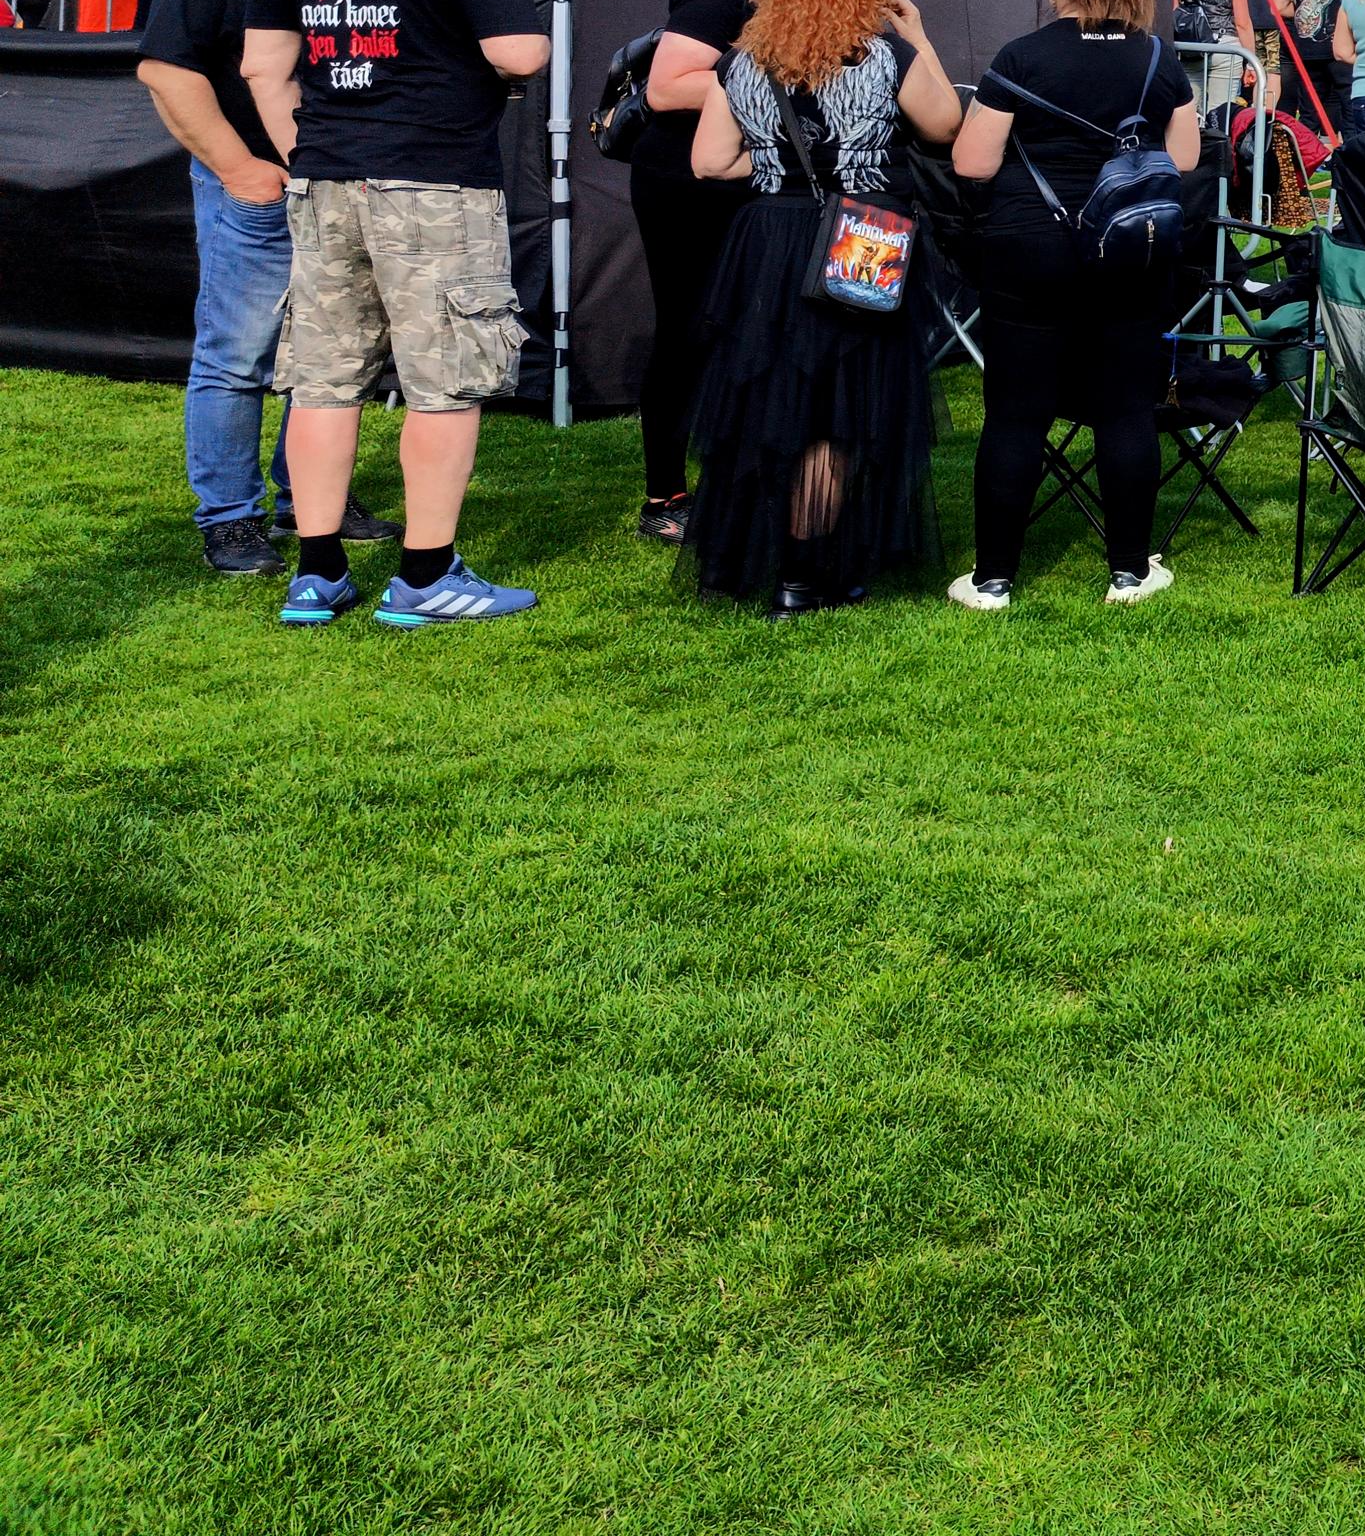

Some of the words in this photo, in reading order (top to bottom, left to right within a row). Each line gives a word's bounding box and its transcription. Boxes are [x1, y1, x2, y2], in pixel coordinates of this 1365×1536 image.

[307, 29, 339, 65] jen
[350, 28, 400, 58] další
[330, 60, 374, 90] část
